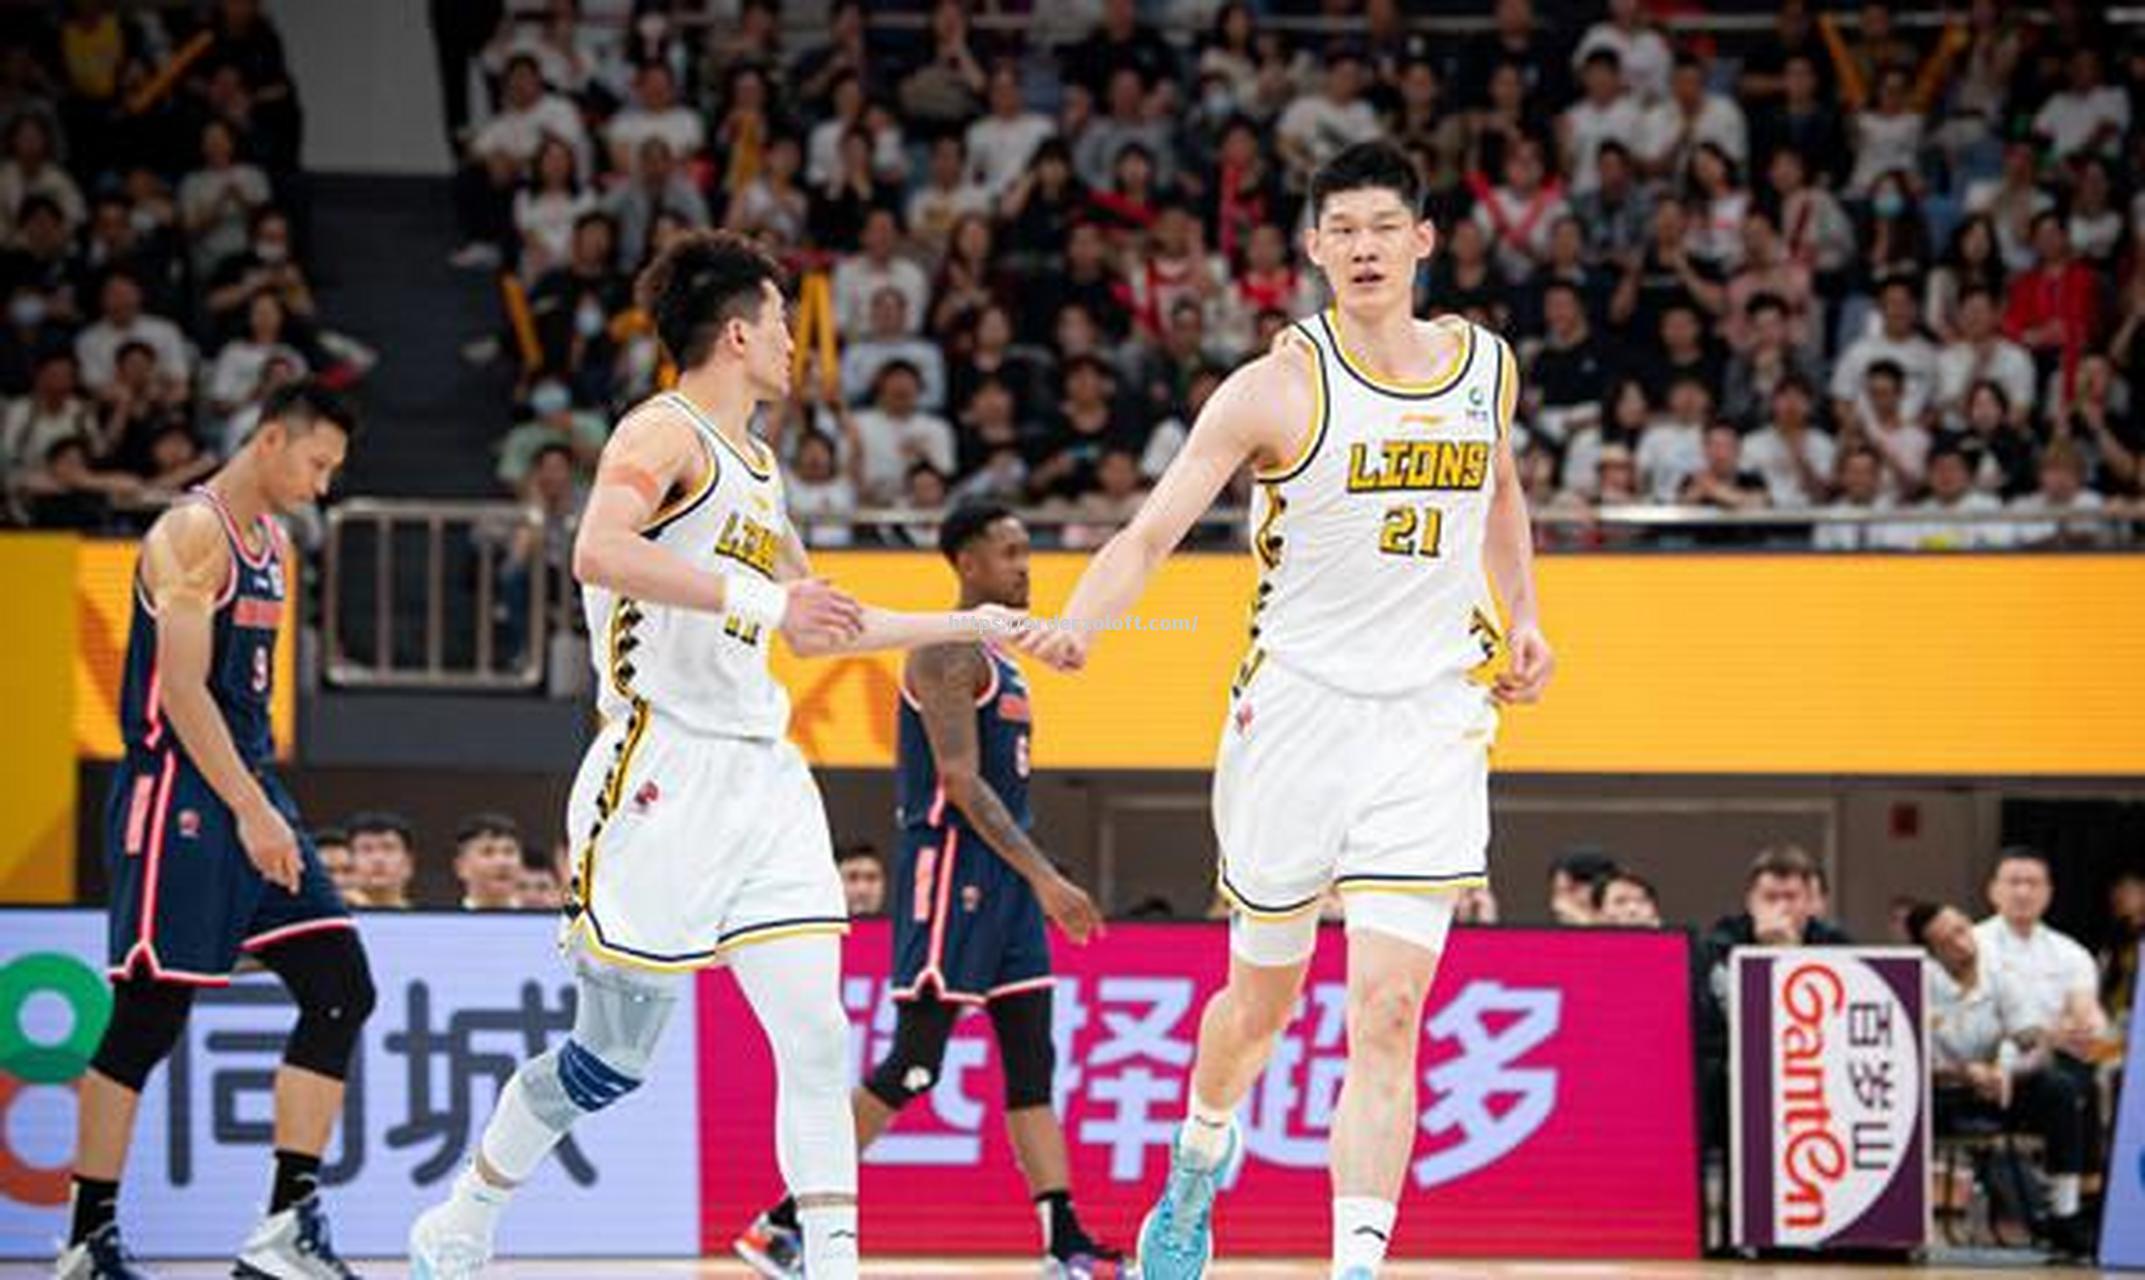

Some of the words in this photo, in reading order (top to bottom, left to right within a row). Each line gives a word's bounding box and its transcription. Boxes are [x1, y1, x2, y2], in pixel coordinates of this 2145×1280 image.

[1347, 439, 1489, 493] LIONS
[1379, 506, 1443, 558] 21
[1848, 1001, 1894, 1170] 百岁山
